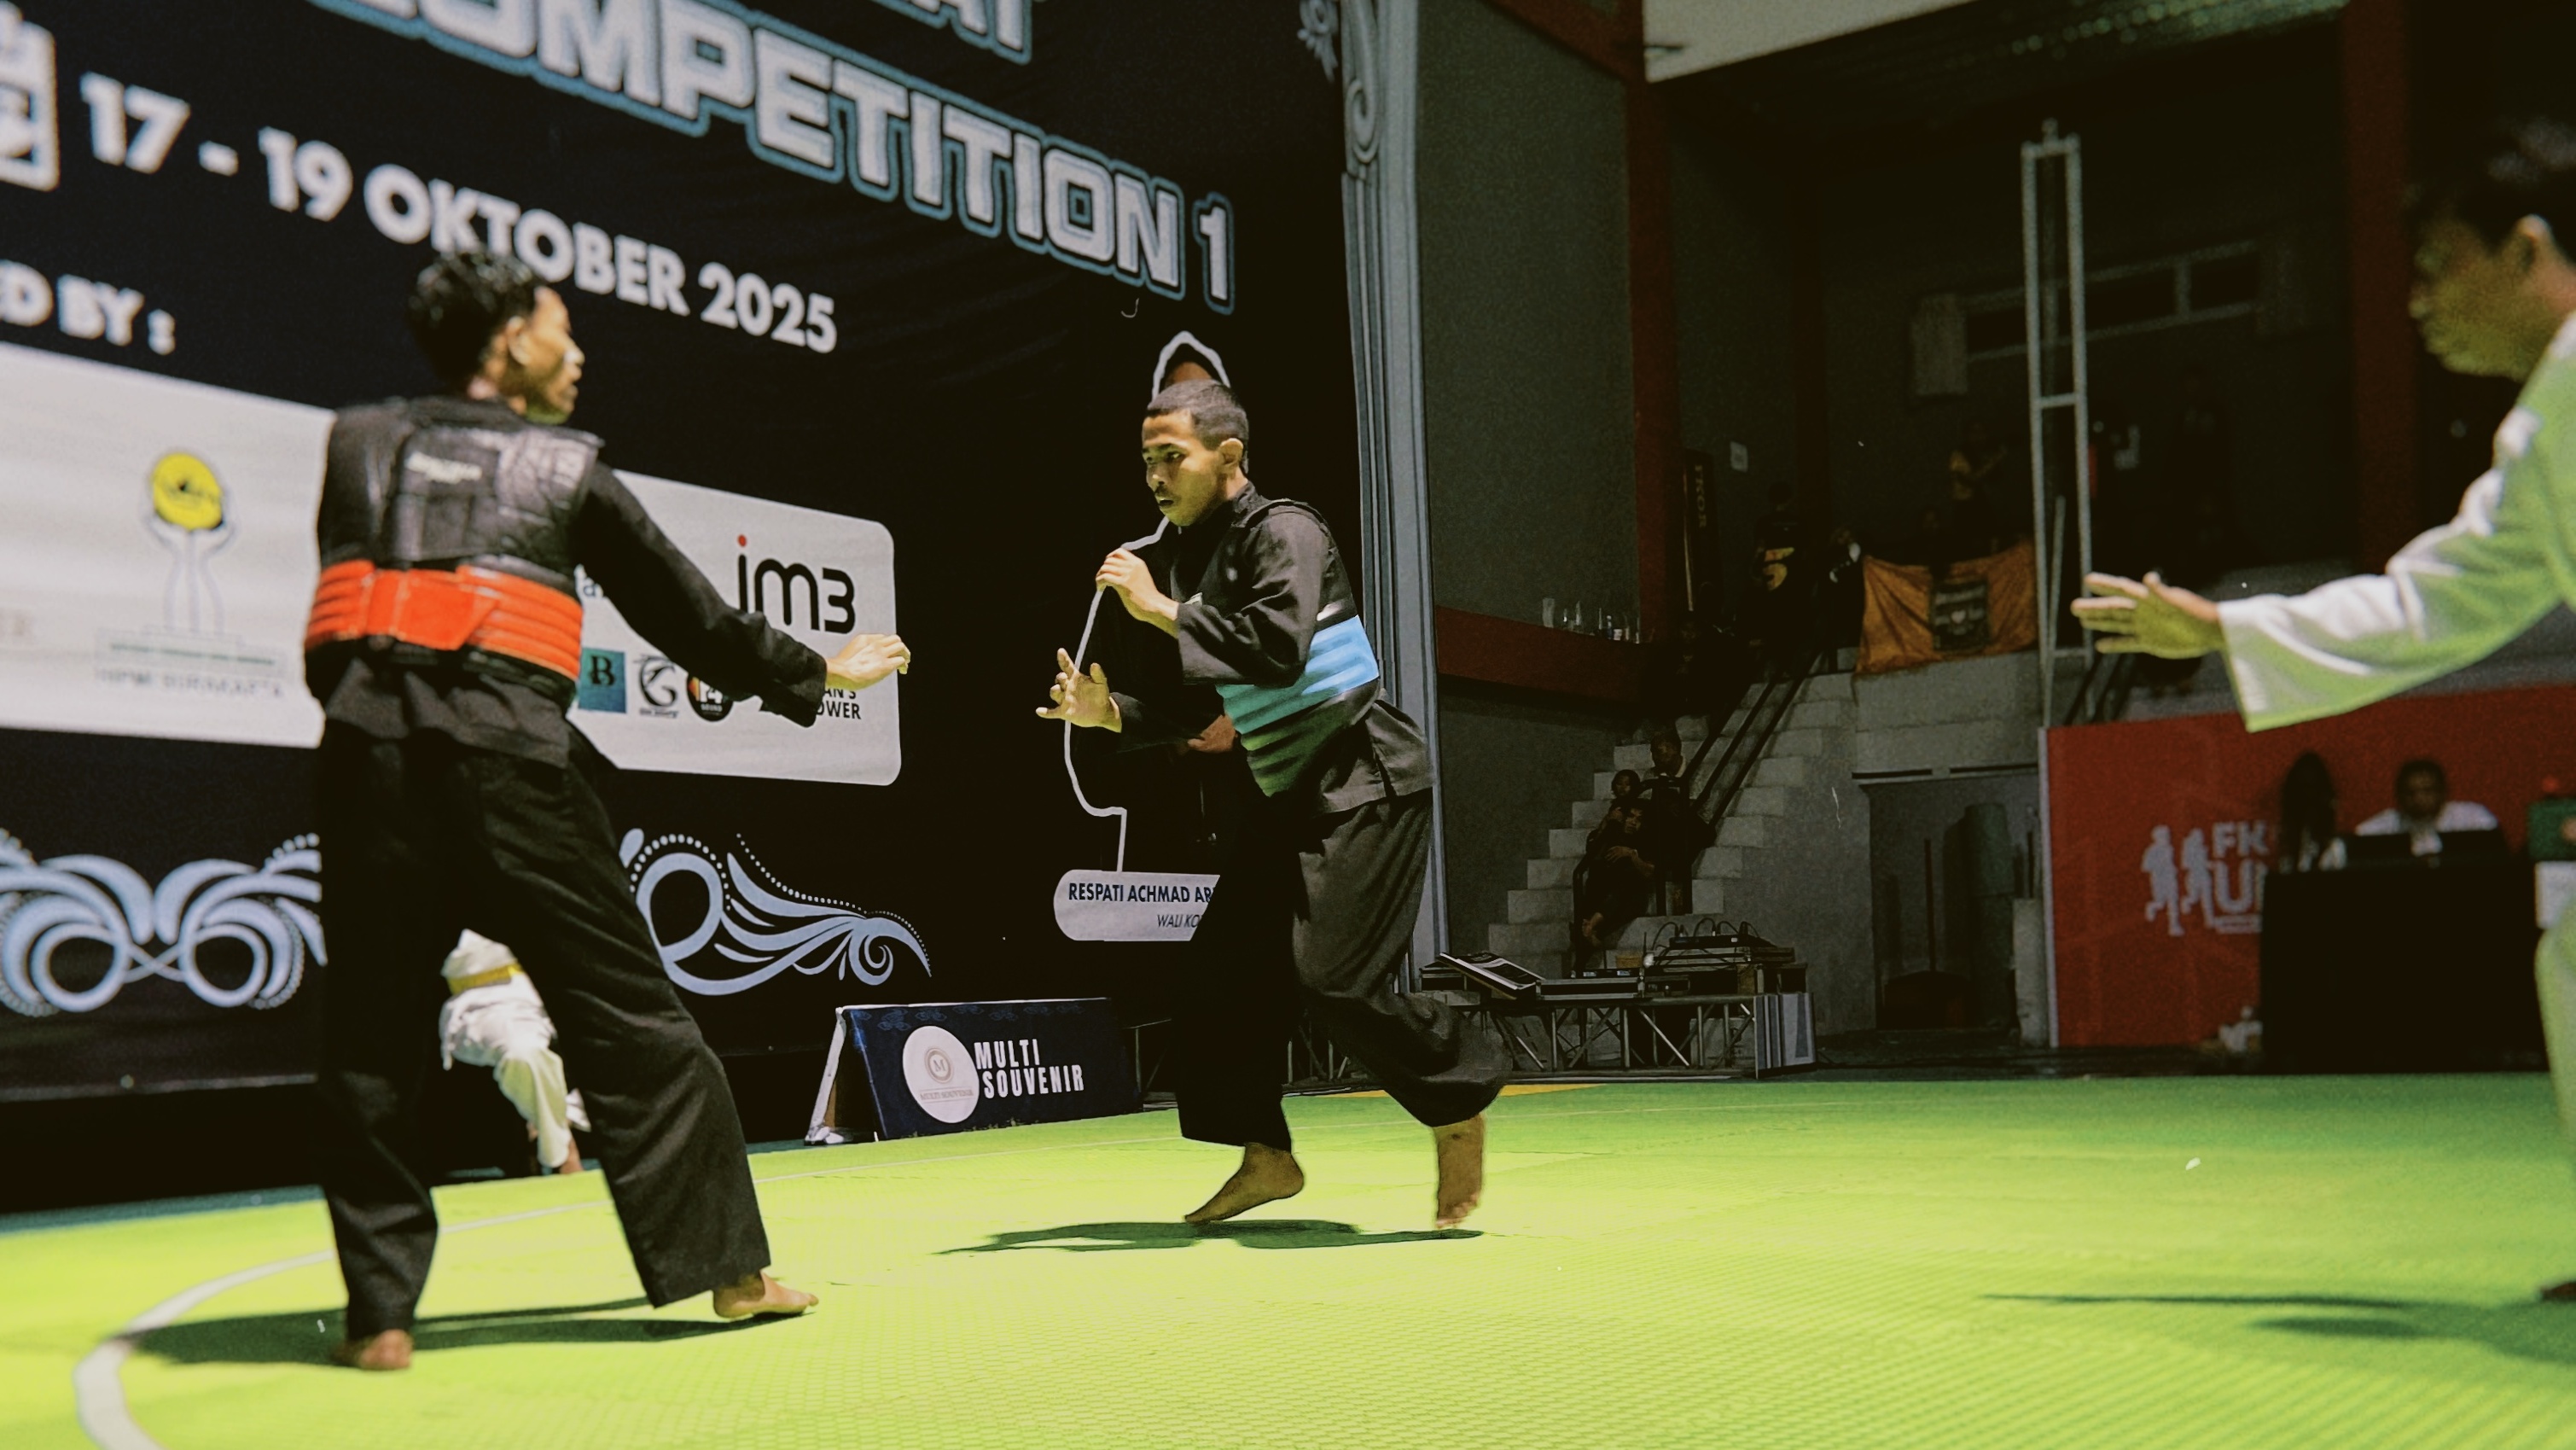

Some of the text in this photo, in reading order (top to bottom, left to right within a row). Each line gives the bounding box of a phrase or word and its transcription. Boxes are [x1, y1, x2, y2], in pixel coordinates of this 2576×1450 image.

[350, 0, 1231, 306] MPETITION 1
[79, 71, 837, 353] 17 - 19 OKTOBER 2025
[57, 273, 144, 346] BY
[1068, 882, 1214, 903] RESPATI ACHMAD AR
[1157, 914, 1203, 928] WALI KO
[974, 1039, 1040, 1069] MULTI
[982, 1064, 1084, 1099] SOUVENIR
